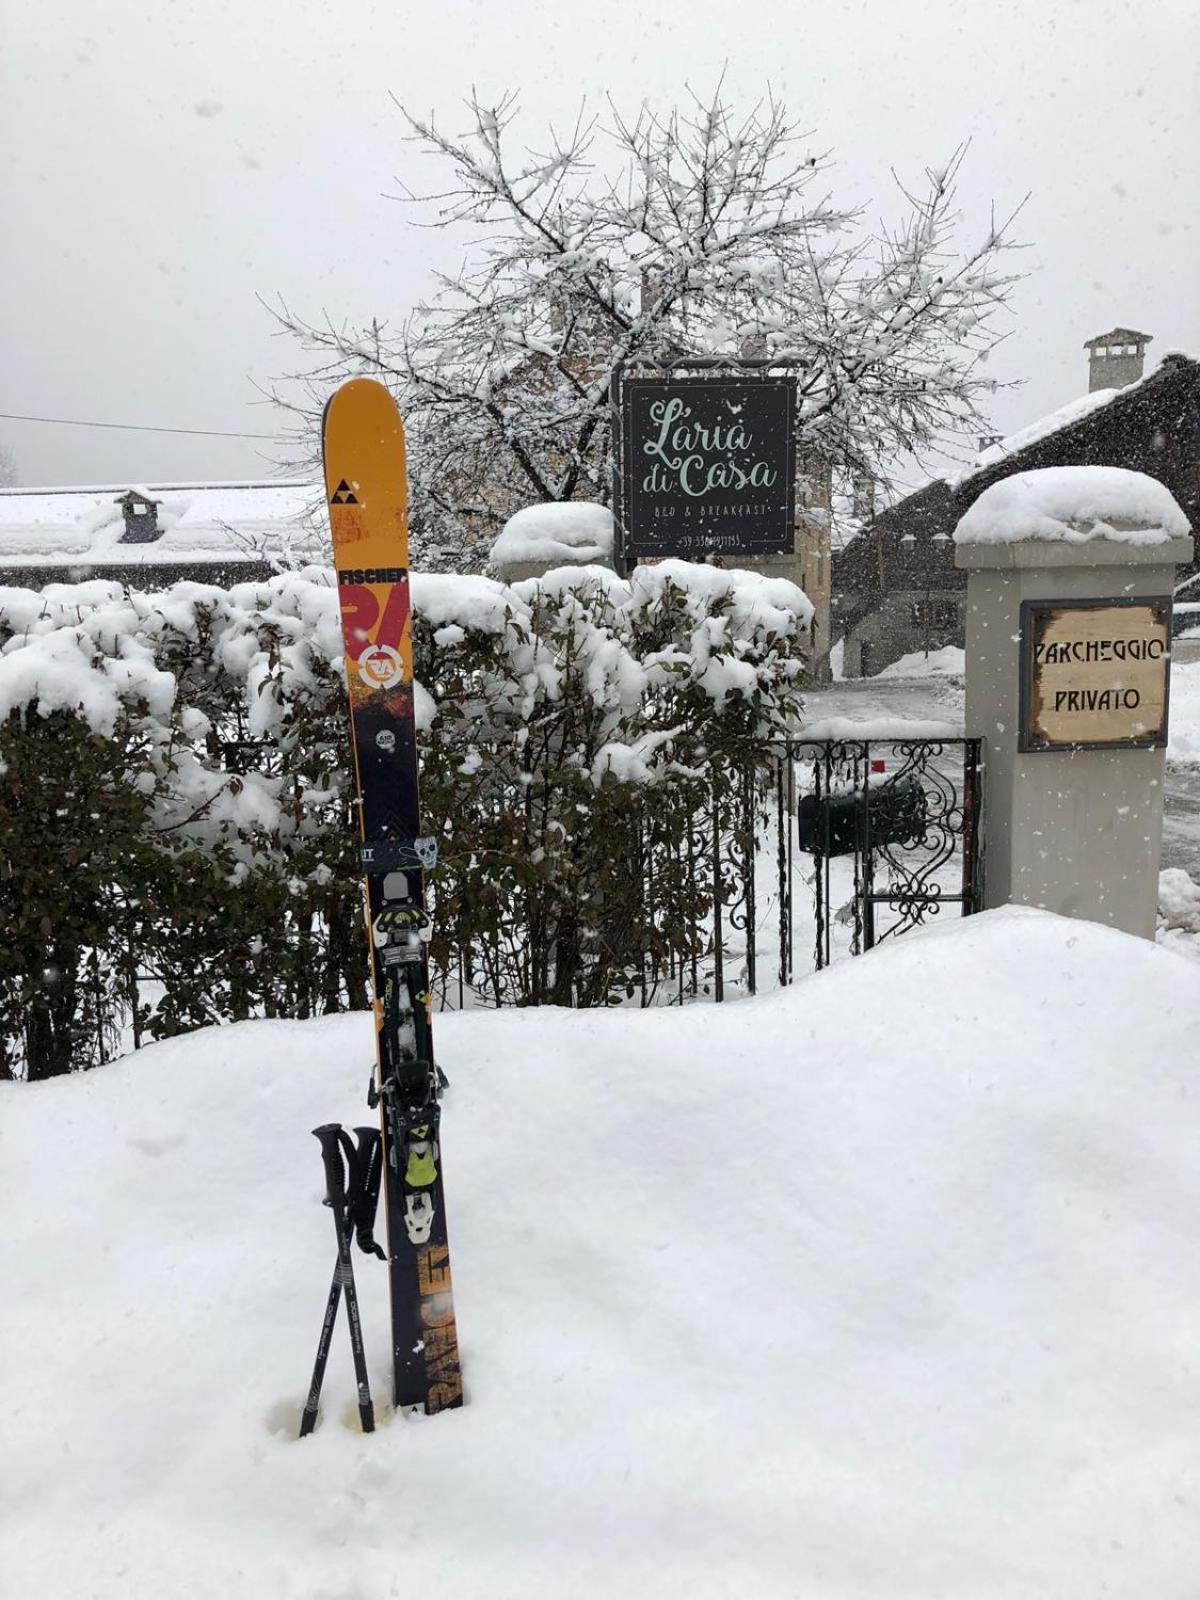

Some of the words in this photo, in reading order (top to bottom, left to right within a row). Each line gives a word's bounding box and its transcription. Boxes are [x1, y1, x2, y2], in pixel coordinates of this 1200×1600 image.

[642, 463, 673, 493] di
[680, 454, 777, 497] Casa
[654, 505, 676, 518] BED
[700, 504, 766, 517] BREAKFAST
[1033, 638, 1165, 664] PARCHEGGIO
[1055, 688, 1141, 712] PRIVATO
